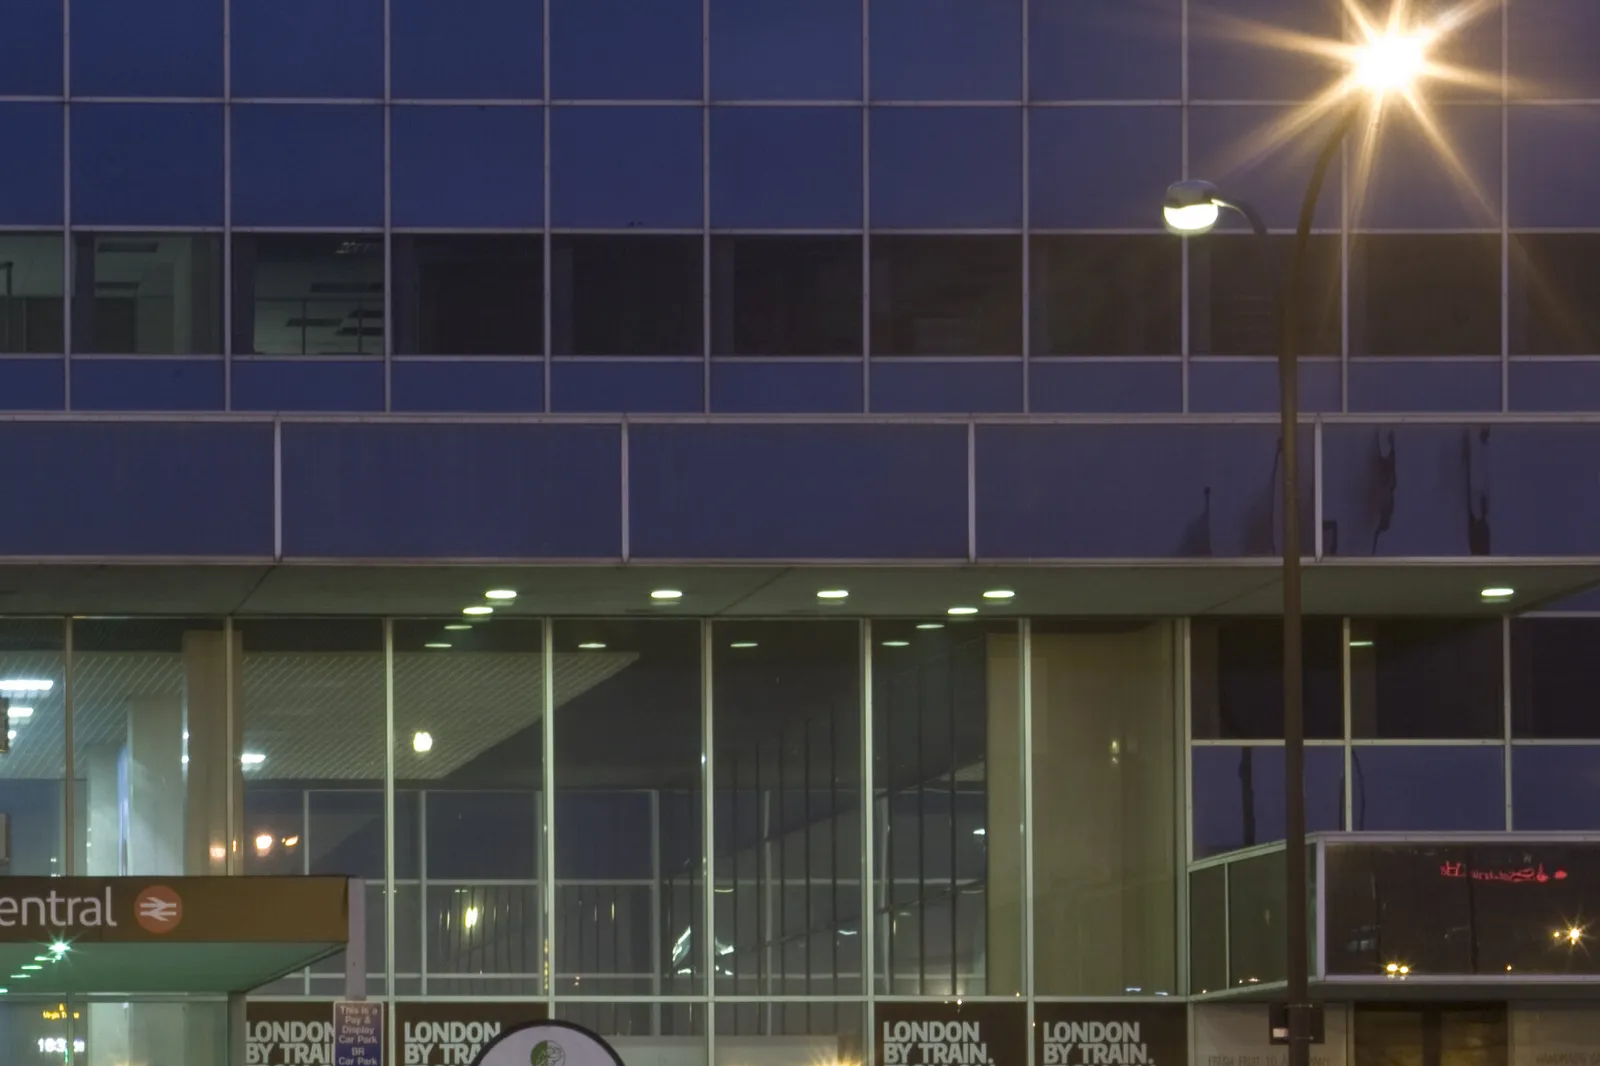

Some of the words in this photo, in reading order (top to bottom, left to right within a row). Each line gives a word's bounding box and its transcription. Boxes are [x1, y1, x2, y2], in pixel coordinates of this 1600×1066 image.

[341, 1006, 359, 1014] This
[342, 1026, 374, 1036] Display
[345, 1016, 361, 1026] Pay
[339, 1036, 355, 1044] Car
[358, 1035, 378, 1044] Park
[883, 1021, 980, 1042] LONDON
[1043, 1021, 1140, 1042] LONDON
[246, 1044, 273, 1064] BY
[339, 1057, 354, 1065] Car
[357, 1057, 378, 1065] Park
[404, 1044, 435, 1064] BY
[883, 1043, 912, 1064] BY
[918, 1043, 994, 1064] TRAIN.
[1043, 1043, 1073, 1064] BY
[1078, 1043, 1154, 1064] TRAIN.
